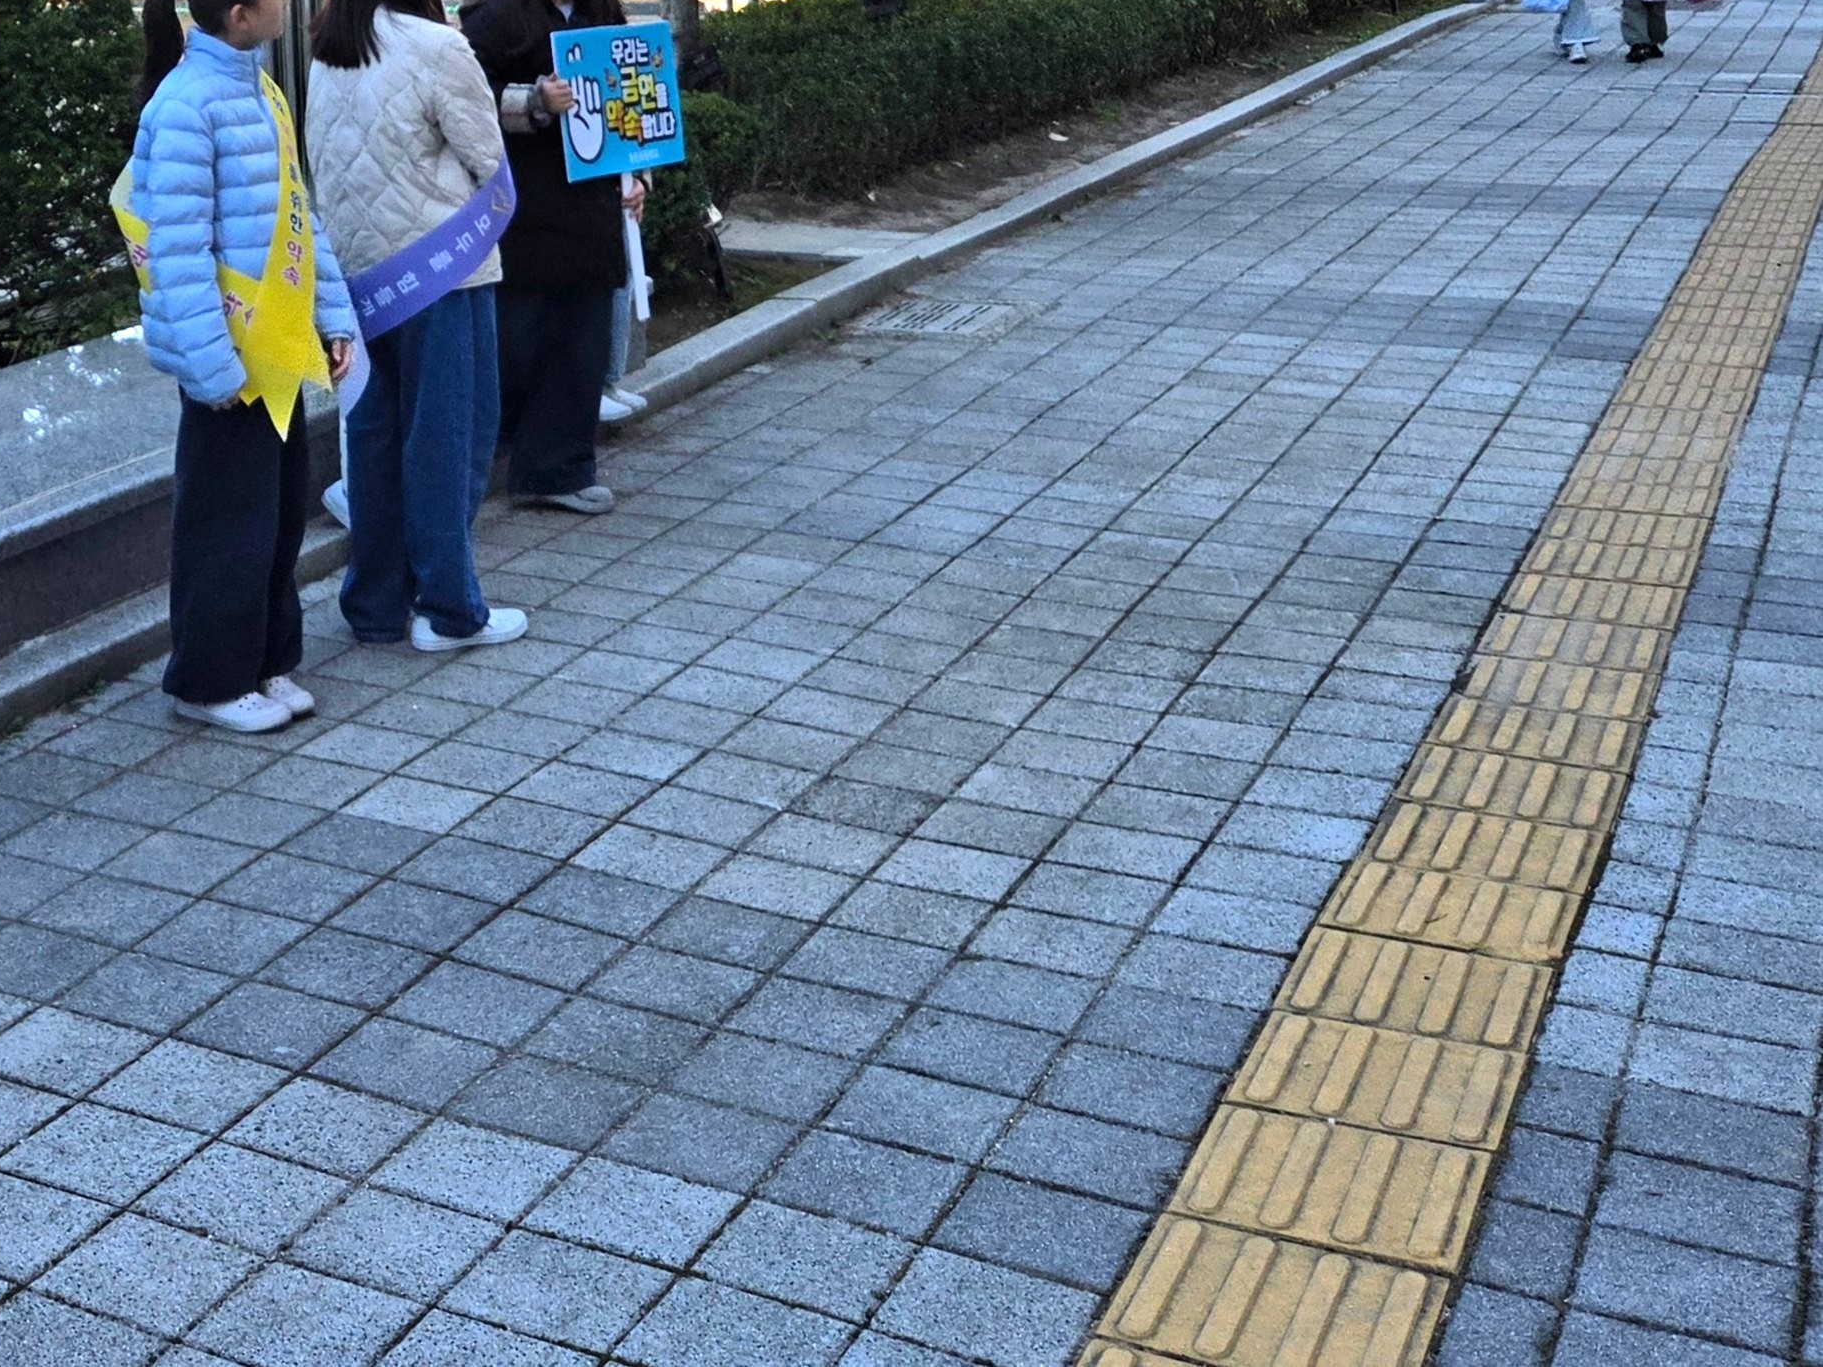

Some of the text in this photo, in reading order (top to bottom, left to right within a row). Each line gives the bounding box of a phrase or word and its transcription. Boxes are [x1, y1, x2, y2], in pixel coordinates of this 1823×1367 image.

[611, 38, 649, 65] 우리는
[620, 66, 668, 111] 금연을
[605, 99, 676, 143] 약속합니다
[428, 213, 491, 273] 모두를
